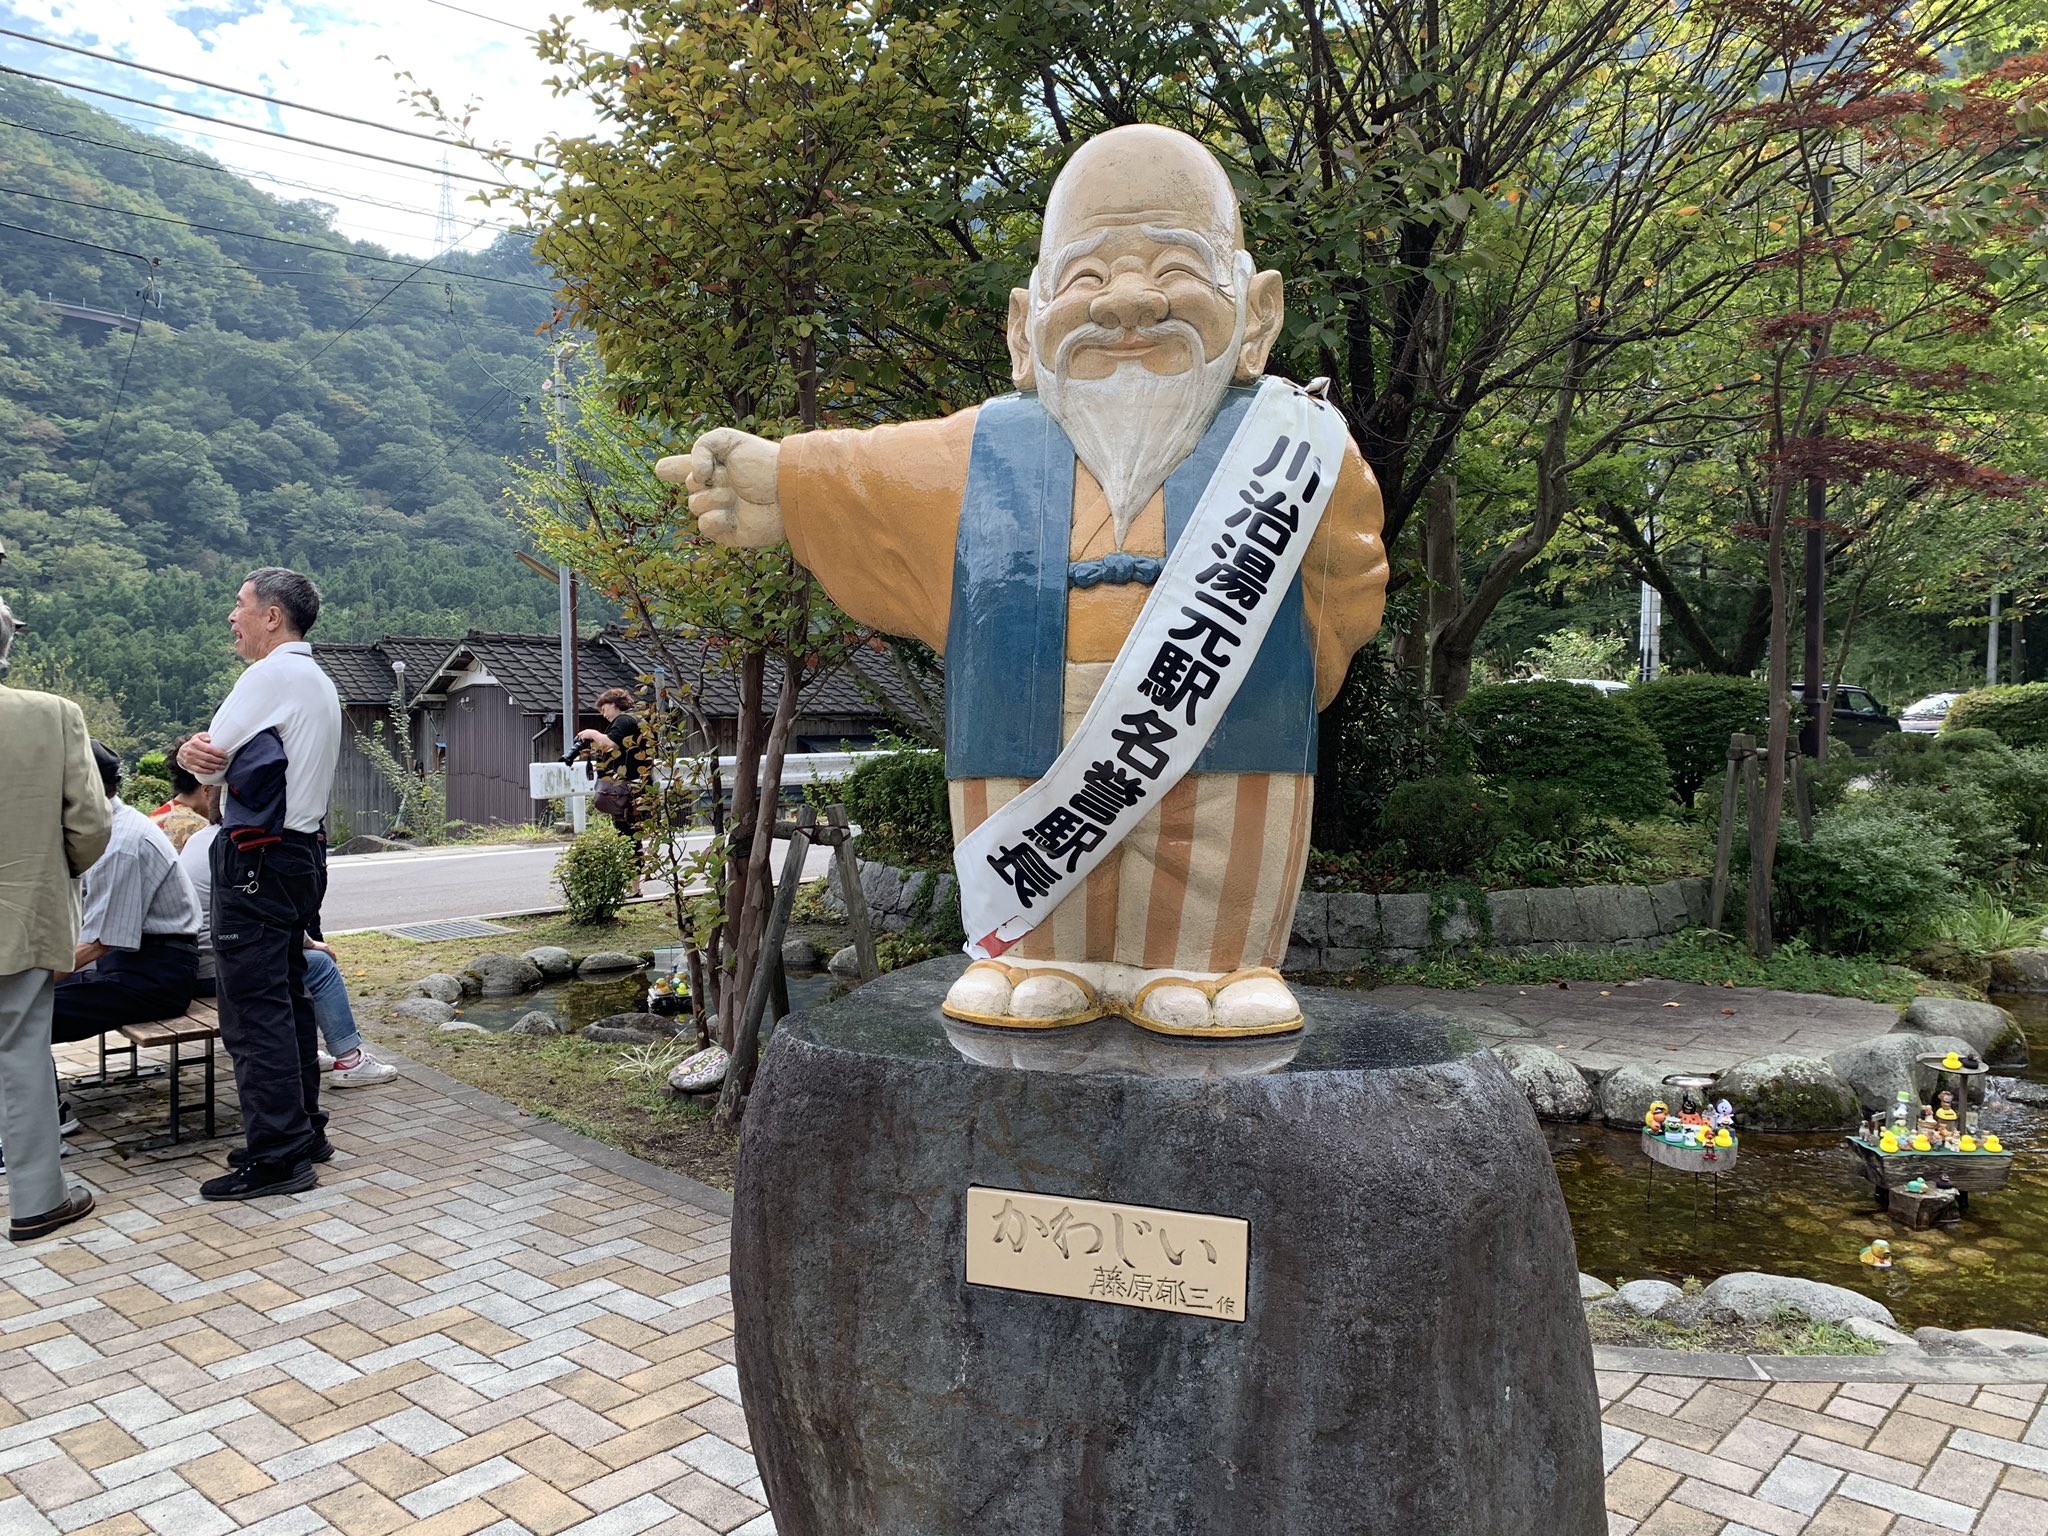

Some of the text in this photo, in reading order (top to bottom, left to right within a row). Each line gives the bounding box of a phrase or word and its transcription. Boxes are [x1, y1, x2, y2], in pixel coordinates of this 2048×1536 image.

[987, 435, 1321, 909] 川治湯元駅名誉駅長
[992, 1199, 1218, 1269] かわじい
